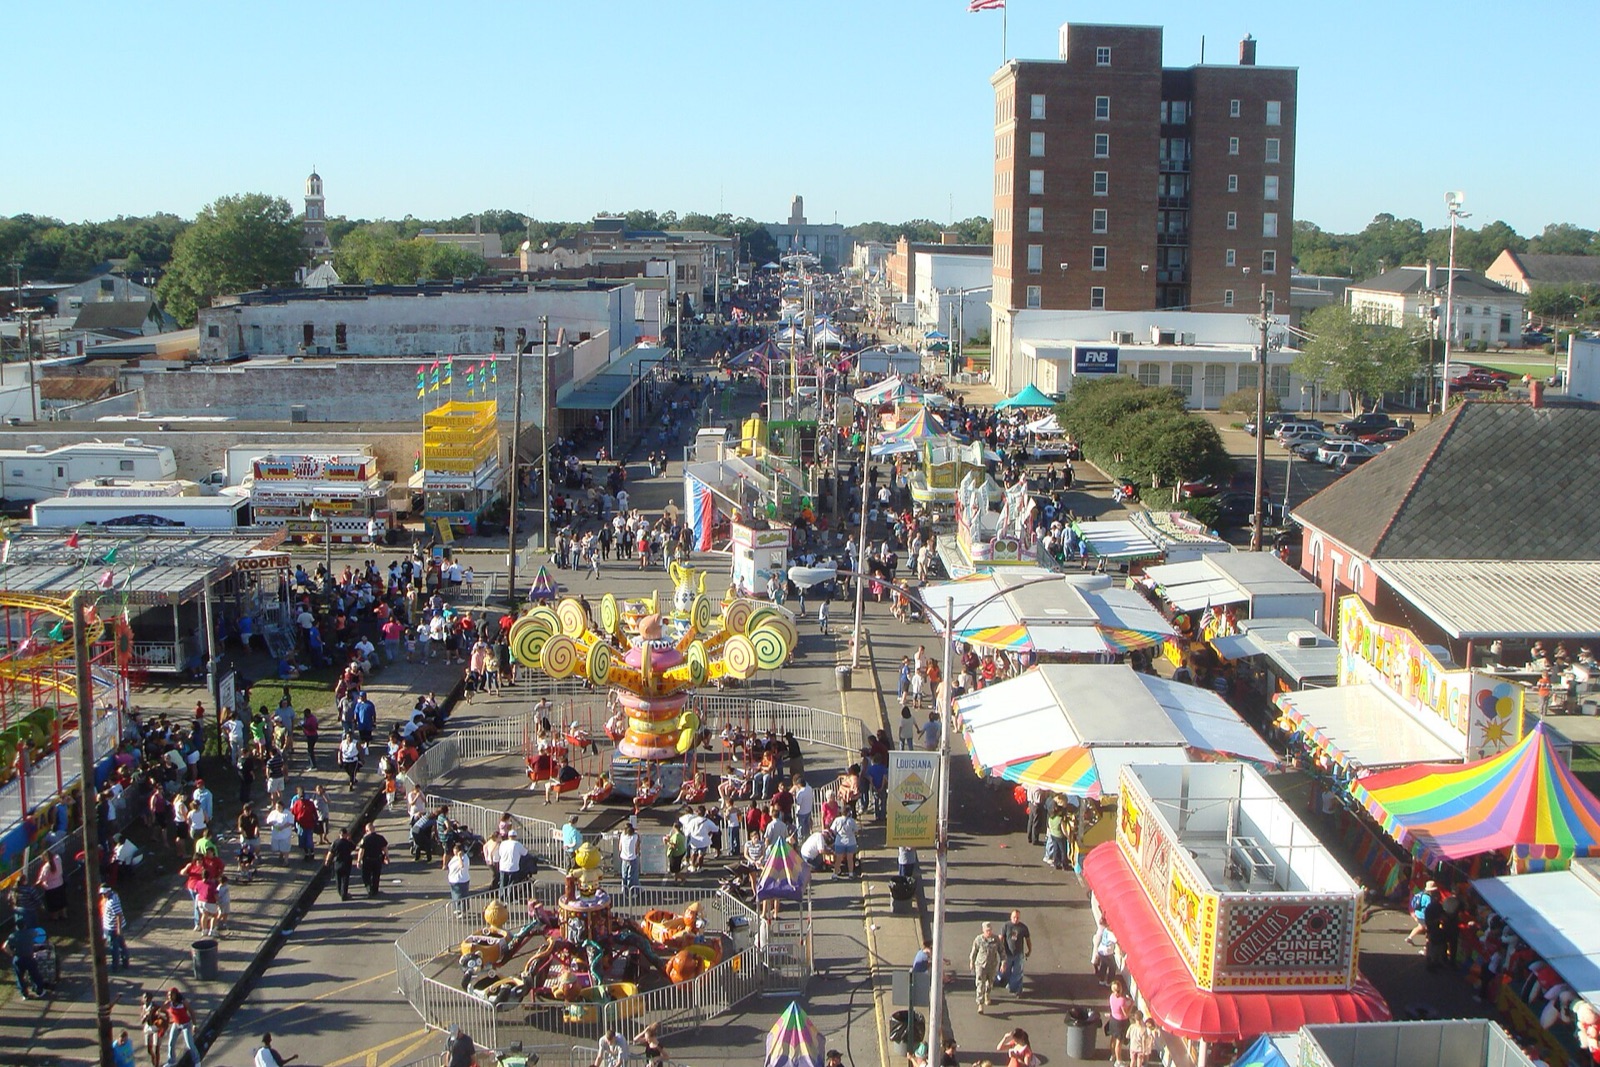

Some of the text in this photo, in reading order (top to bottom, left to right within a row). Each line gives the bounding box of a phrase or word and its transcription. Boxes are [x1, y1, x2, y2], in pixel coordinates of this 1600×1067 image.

[1085, 351, 1108, 362] FNB
[426, 416, 473, 426] ELEPHANT EARS
[425, 448, 473, 457] HAMBURGER
[72, 488, 93, 497] SNOW
[120, 489, 141, 497] CANDY
[238, 556, 290, 570] SCOOTER
[1355, 617, 1470, 736] PRIZE PALACE
[896, 758, 932, 769] LOUISIANA
[894, 811, 929, 823] Remember
[894, 823, 927, 836] November
[1202, 897, 1214, 977] COLD DRINKS
[1233, 909, 1289, 964] GAZELLA'S
[1276, 940, 1332, 950] DINER
[1265, 951, 1332, 961] & GRILL
[1231, 976, 1329, 986] FUNNEL CAKES
